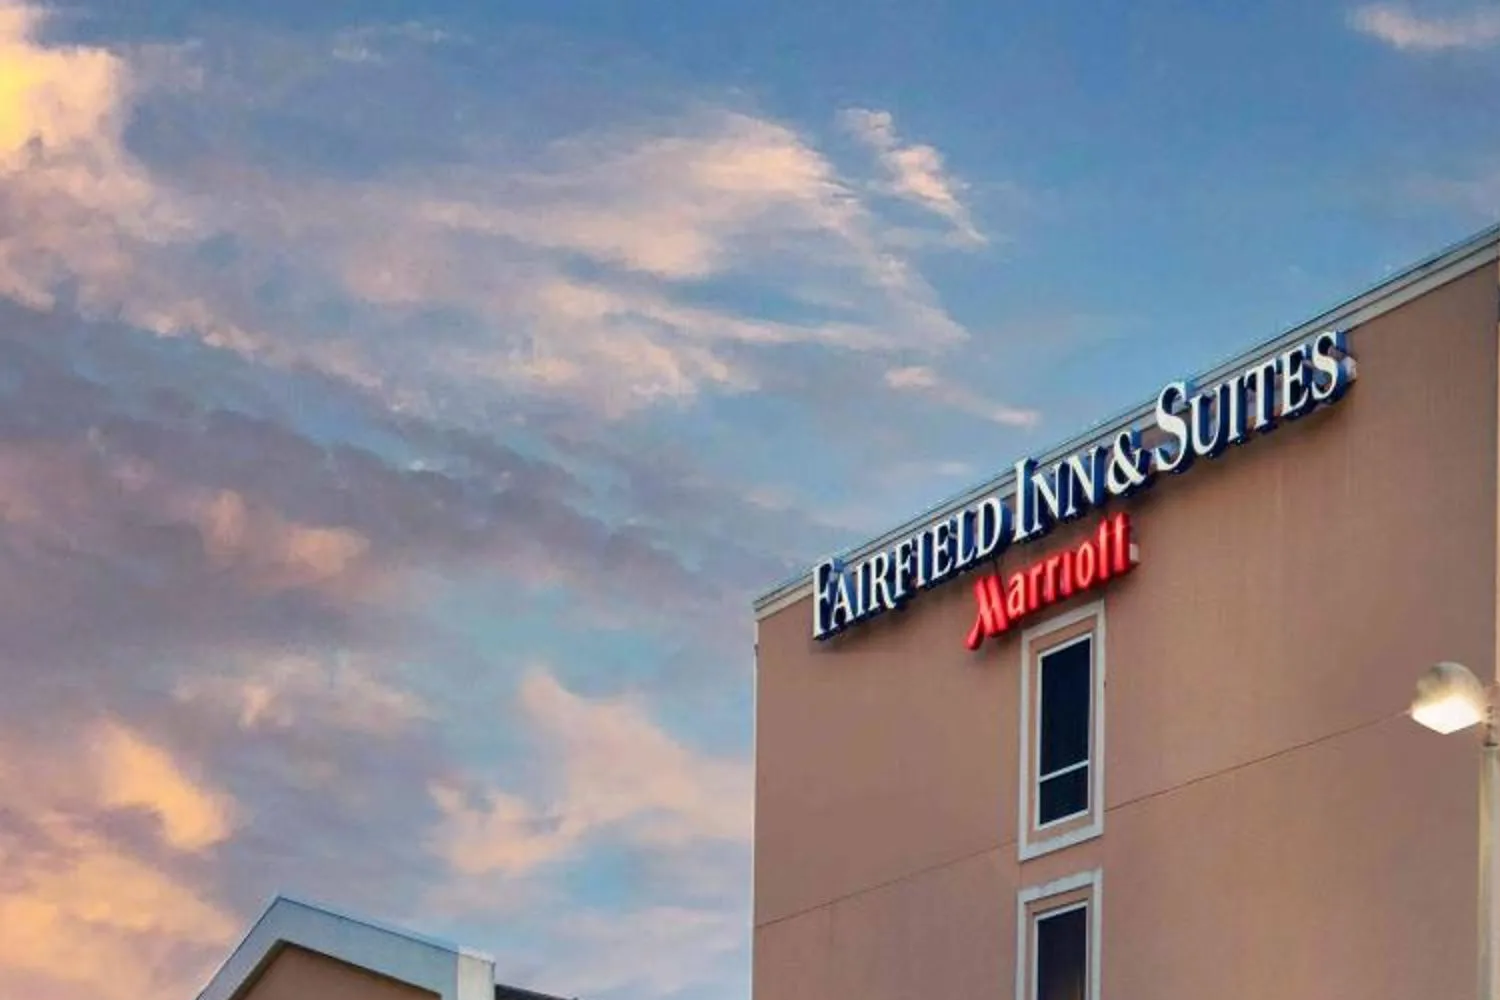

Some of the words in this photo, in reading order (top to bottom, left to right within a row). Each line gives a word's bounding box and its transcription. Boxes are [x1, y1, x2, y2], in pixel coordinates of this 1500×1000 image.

[812, 497, 1004, 638] FAIRFIELD
[1012, 457, 1104, 542] INN
[1107, 431, 1146, 496] &
[1154, 330, 1344, 472] SUITES
[964, 513, 1131, 650] Marriott
